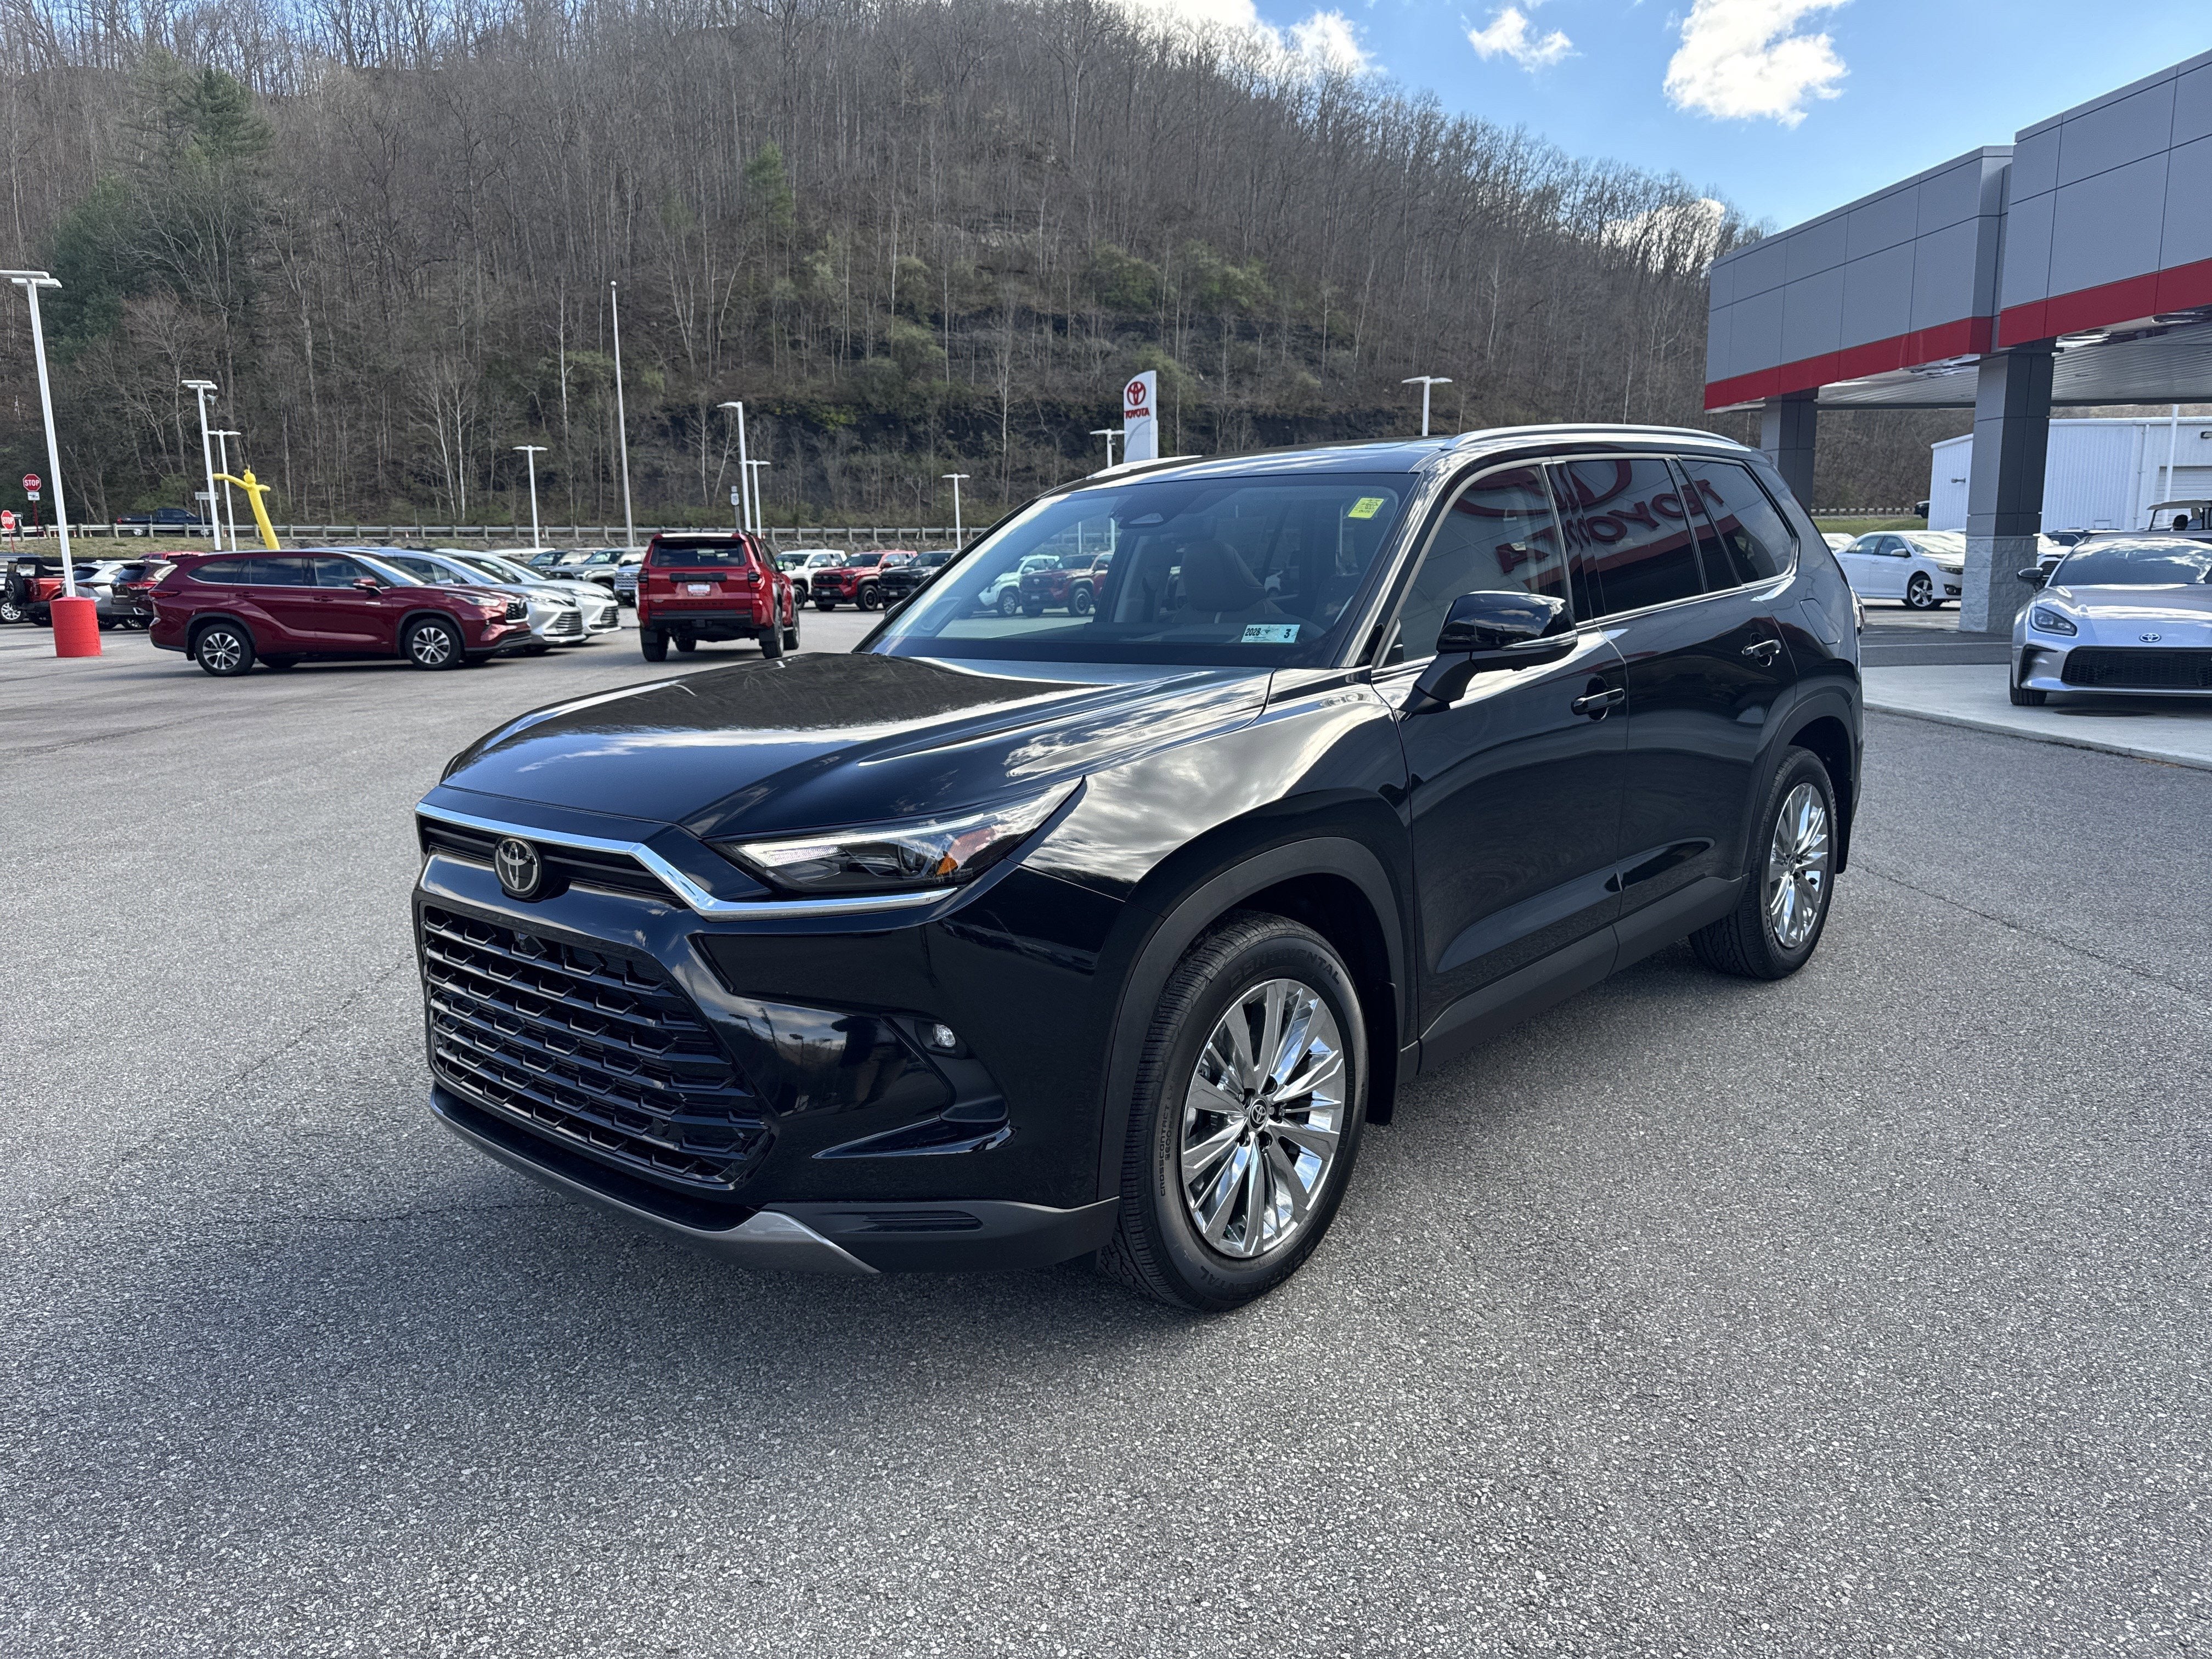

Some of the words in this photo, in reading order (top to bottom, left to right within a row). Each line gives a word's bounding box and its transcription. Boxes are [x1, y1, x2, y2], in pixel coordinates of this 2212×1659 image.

[1125, 408, 1150, 419] TOYOTA
[2, 517, 14, 525] STOP
[1245, 628, 1261, 636] 2028
[1284, 629, 1291, 639] 3
[1159, 1104, 1170, 1197] CROSSCONTACT
